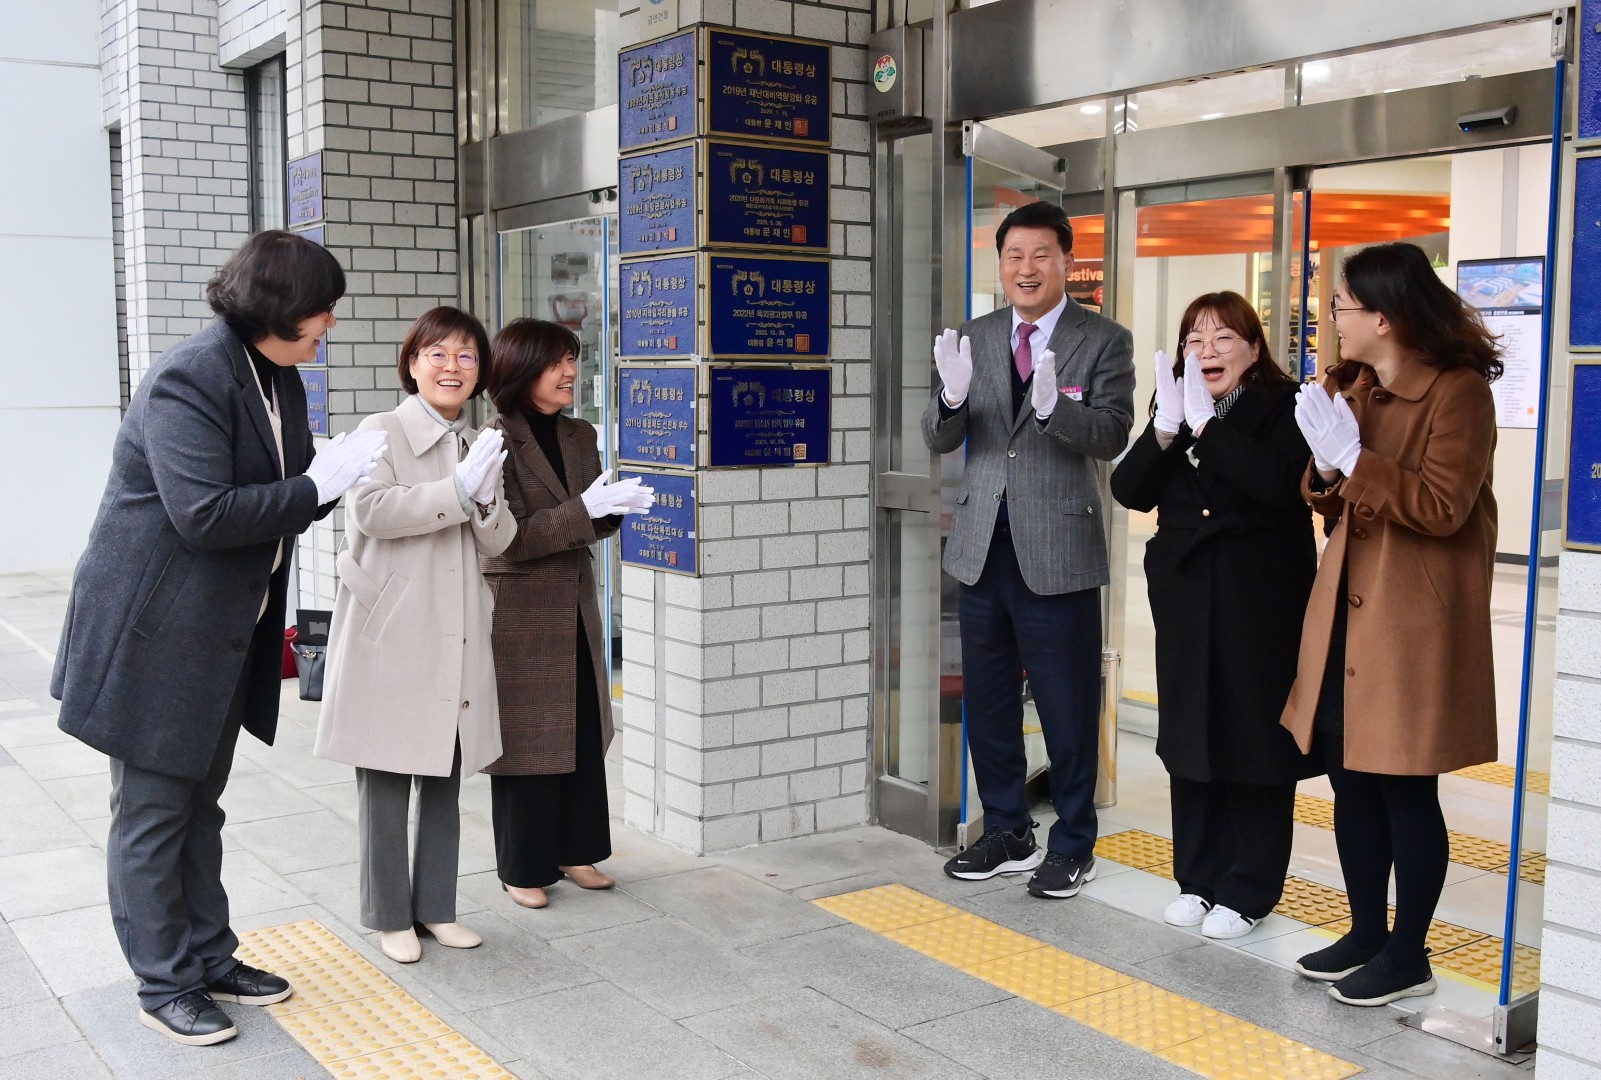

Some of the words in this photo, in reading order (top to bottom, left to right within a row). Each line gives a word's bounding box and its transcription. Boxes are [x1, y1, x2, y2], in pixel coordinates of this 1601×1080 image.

[648, 10, 668, 25] 금연건물
[655, 52, 684, 72] 대통령상
[771, 60, 816, 78] 대통령상
[722, 85, 747, 96] 2019년
[749, 88, 802, 102] 재난대비역량강화
[805, 95, 817, 105] 유공
[744, 118, 762, 128] 대통령
[654, 166, 683, 182] 대통령상
[770, 169, 814, 185] 대통령상
[676, 198, 687, 208] 유공
[750, 196, 775, 205] 다문화가족
[777, 198, 797, 206] 사회통합
[744, 228, 760, 236] 대통령
[656, 276, 686, 291] 대통령상
[771, 280, 815, 294] 대통령상
[642, 307, 677, 318] 지역일자리창출
[679, 306, 689, 317] 유공
[733, 309, 754, 318] 2022년
[757, 310, 793, 319] 옥외광고업무
[795, 311, 807, 320] 유공
[748, 339, 763, 347] 대통령
[655, 388, 684, 401] 대통령상
[772, 388, 815, 402] 대통령상
[625, 418, 642, 428] 2011년
[678, 422, 688, 431] 우수
[795, 418, 805, 428] 유공
[631, 522, 646, 532] 제4회
[648, 524, 684, 538] 다산목민대상
